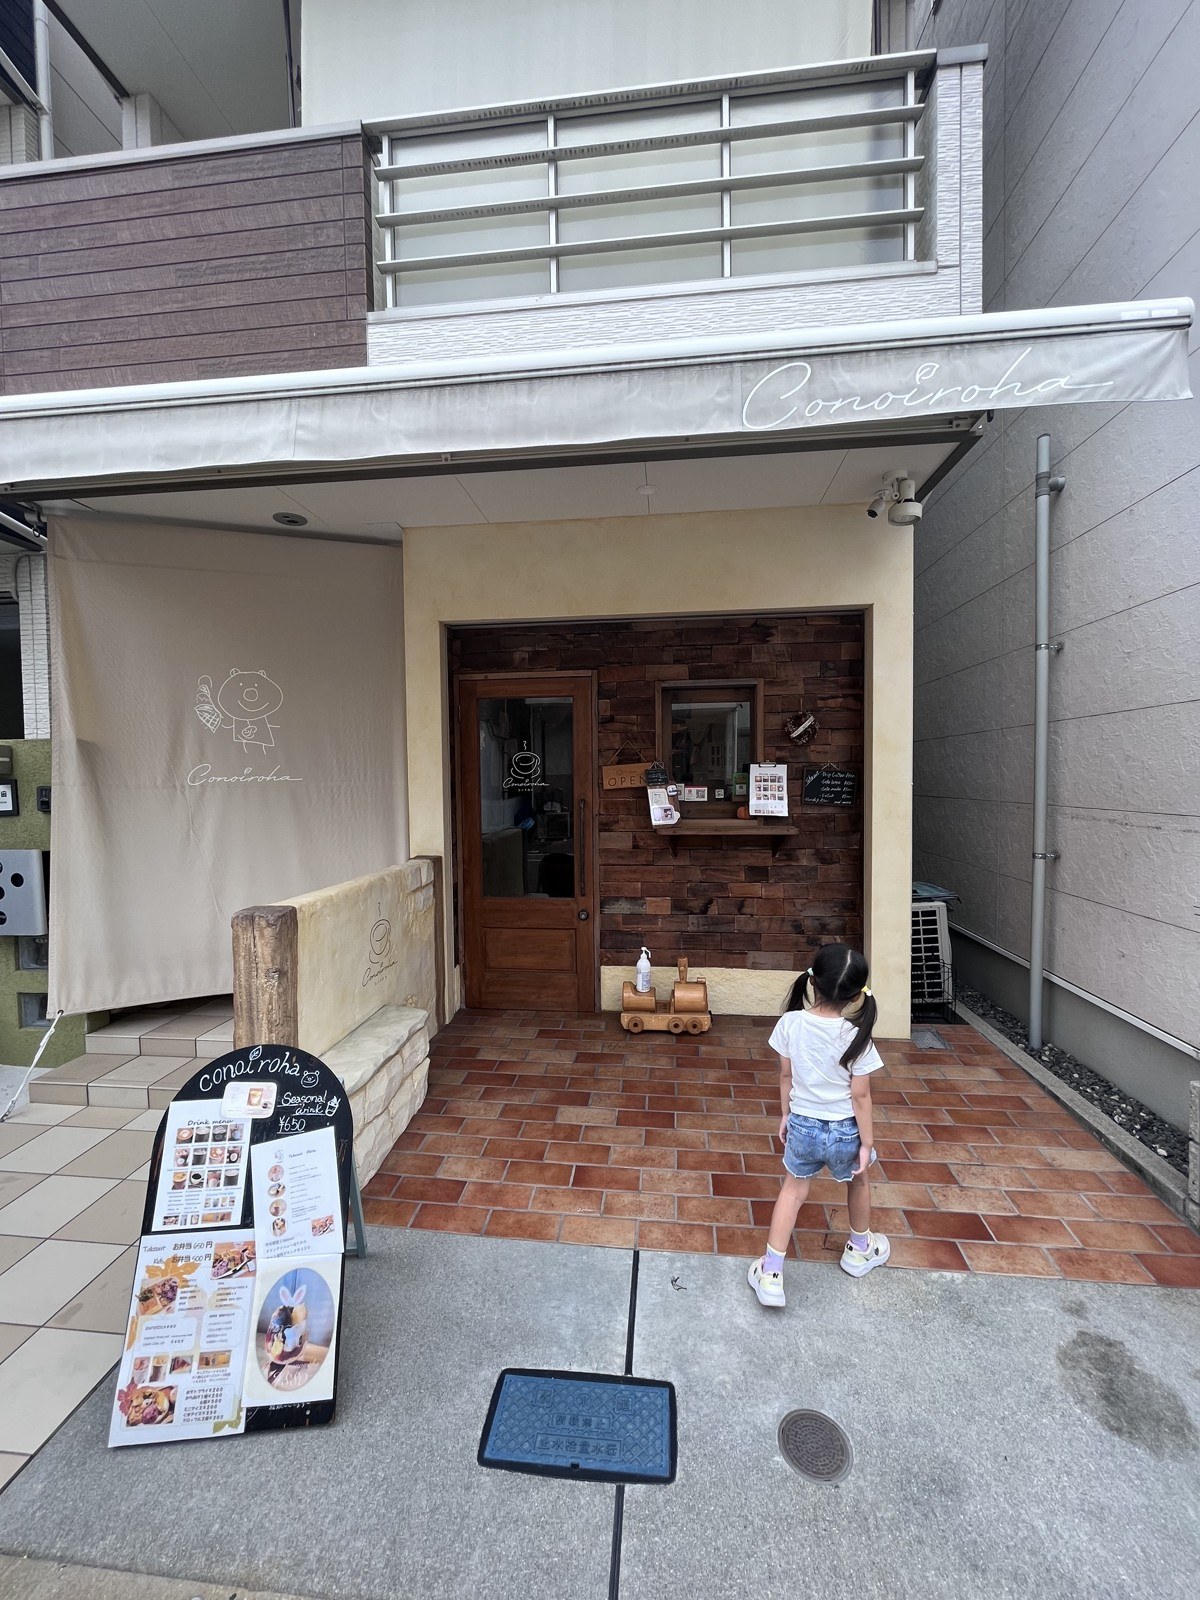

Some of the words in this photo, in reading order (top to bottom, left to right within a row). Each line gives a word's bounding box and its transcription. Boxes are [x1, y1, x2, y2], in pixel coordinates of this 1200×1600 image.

[742, 346, 1114, 430] Conoiroha
[187, 763, 303, 785] Conoiroha
[281, 1090, 328, 1107] Seasonal
[295, 1101, 324, 1115] drink
[279, 1115, 305, 1132] ¥650
